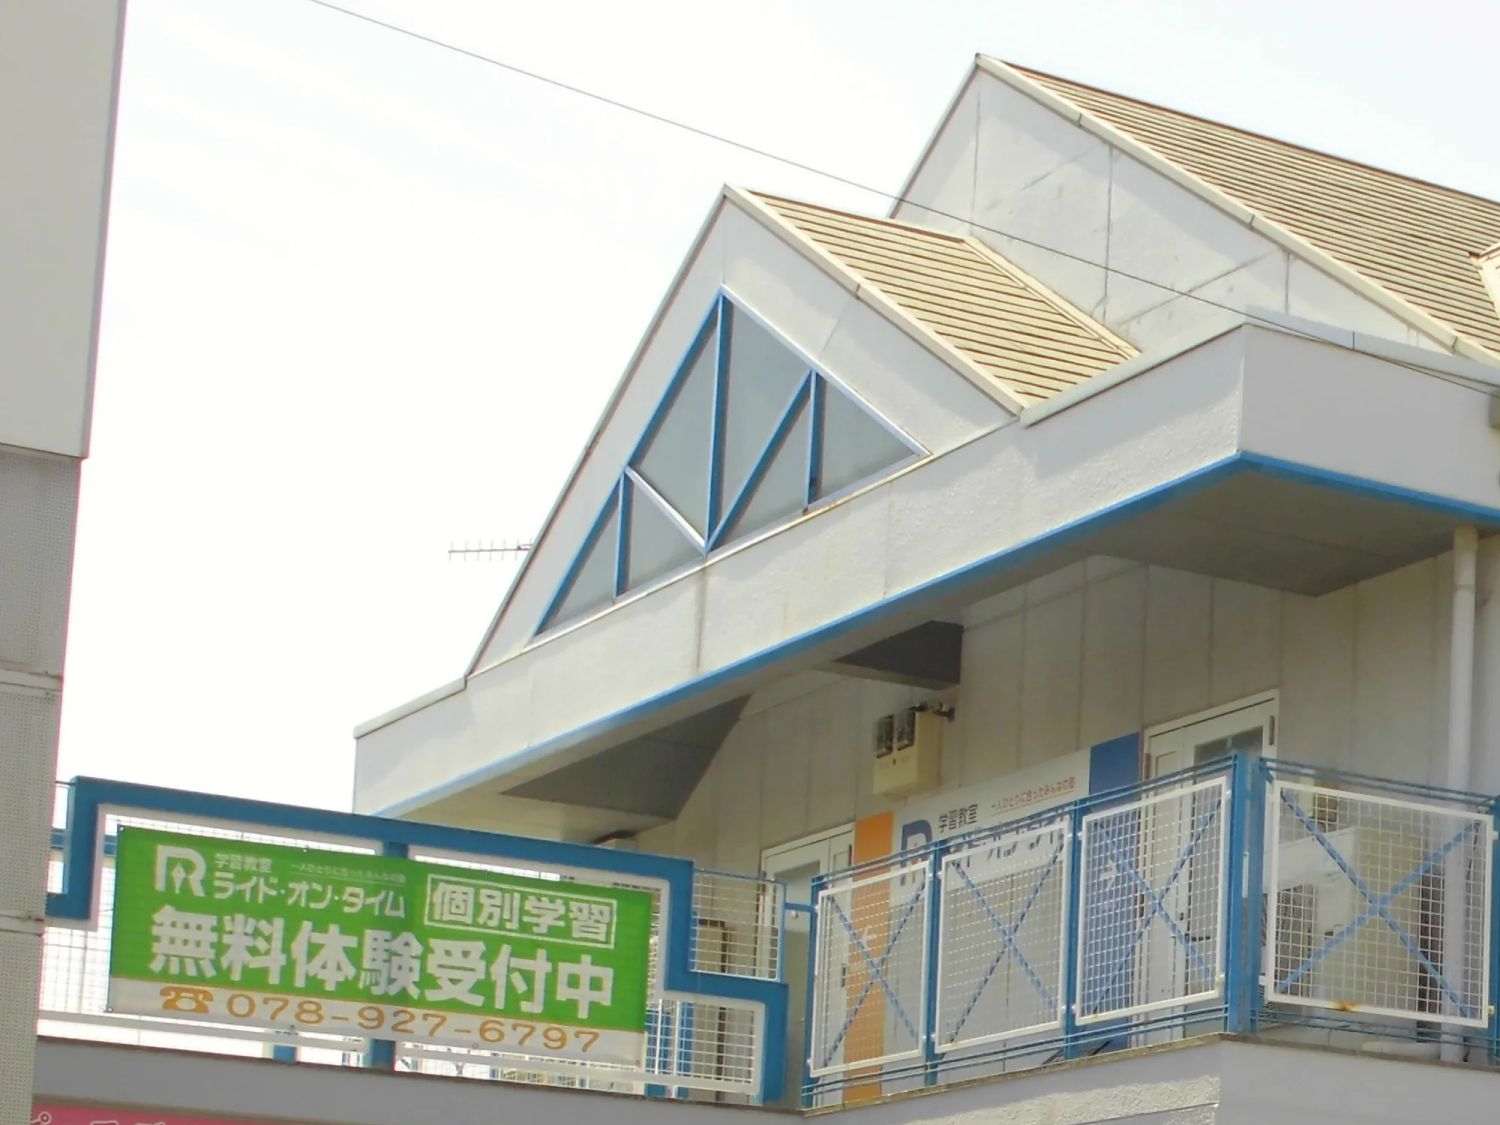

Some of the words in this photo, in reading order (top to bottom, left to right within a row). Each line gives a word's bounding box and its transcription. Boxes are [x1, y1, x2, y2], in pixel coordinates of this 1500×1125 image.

[938, 803, 979, 834] 学習教室
[214, 853, 272, 873] 学習教室
[432, 882, 612, 943] 個別学習
[149, 904, 615, 1020] 無料体験受付中
[227, 992, 601, 1053] 078-927-6797
